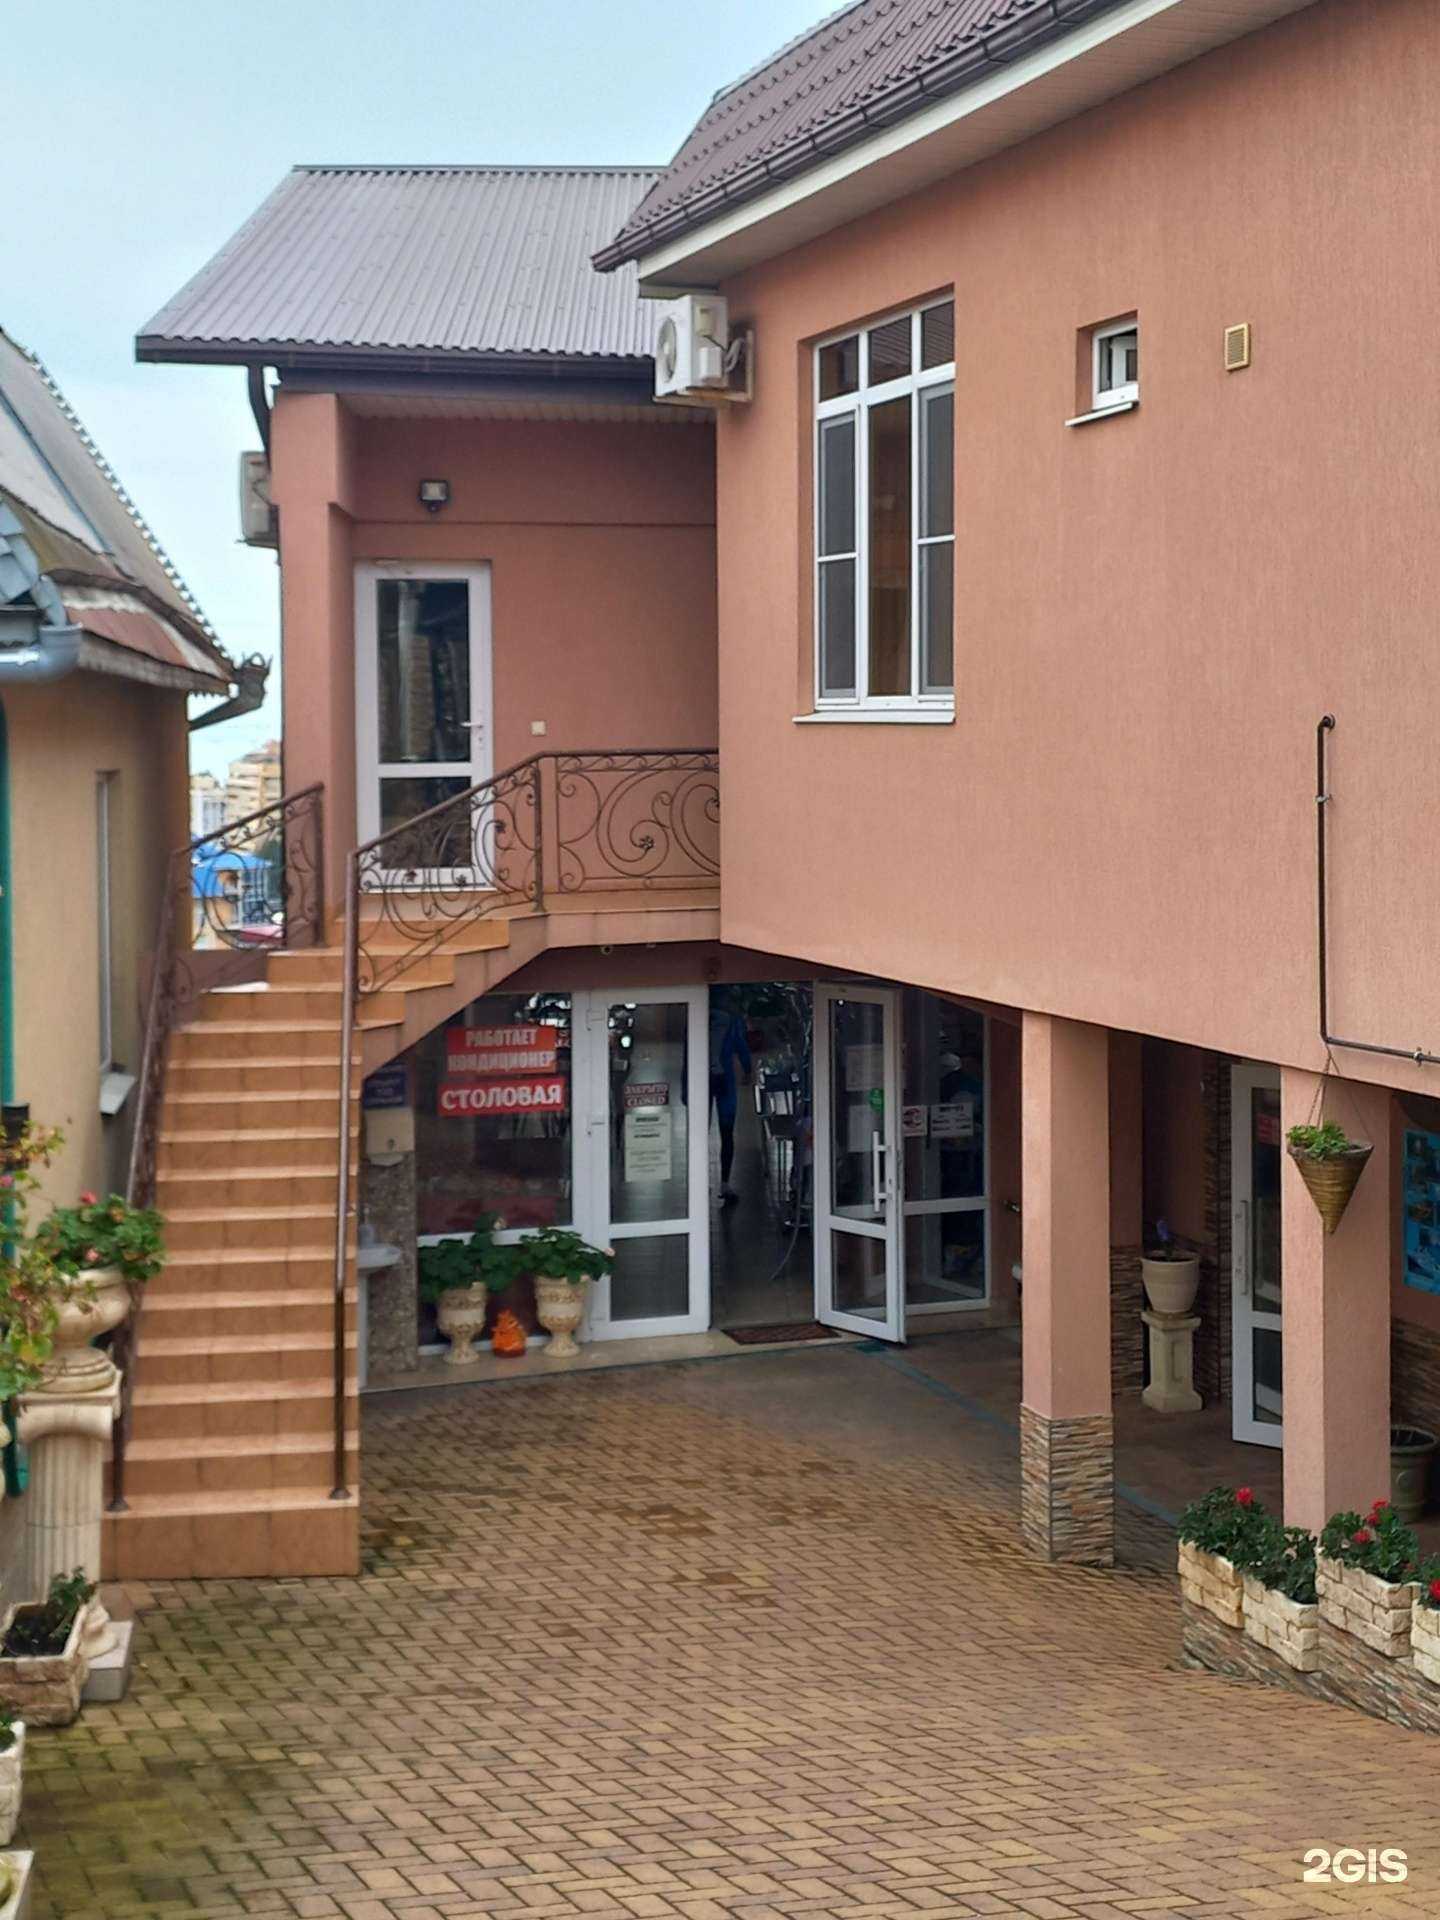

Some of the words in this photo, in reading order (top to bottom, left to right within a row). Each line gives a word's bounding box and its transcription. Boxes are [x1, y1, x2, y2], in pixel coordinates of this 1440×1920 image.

[465, 1028, 538, 1047] РАБОТАЕТ
[447, 1051, 556, 1071] КОНДИЦИОНЕР
[440, 1085, 561, 1110] СТОЛОВАЯ
